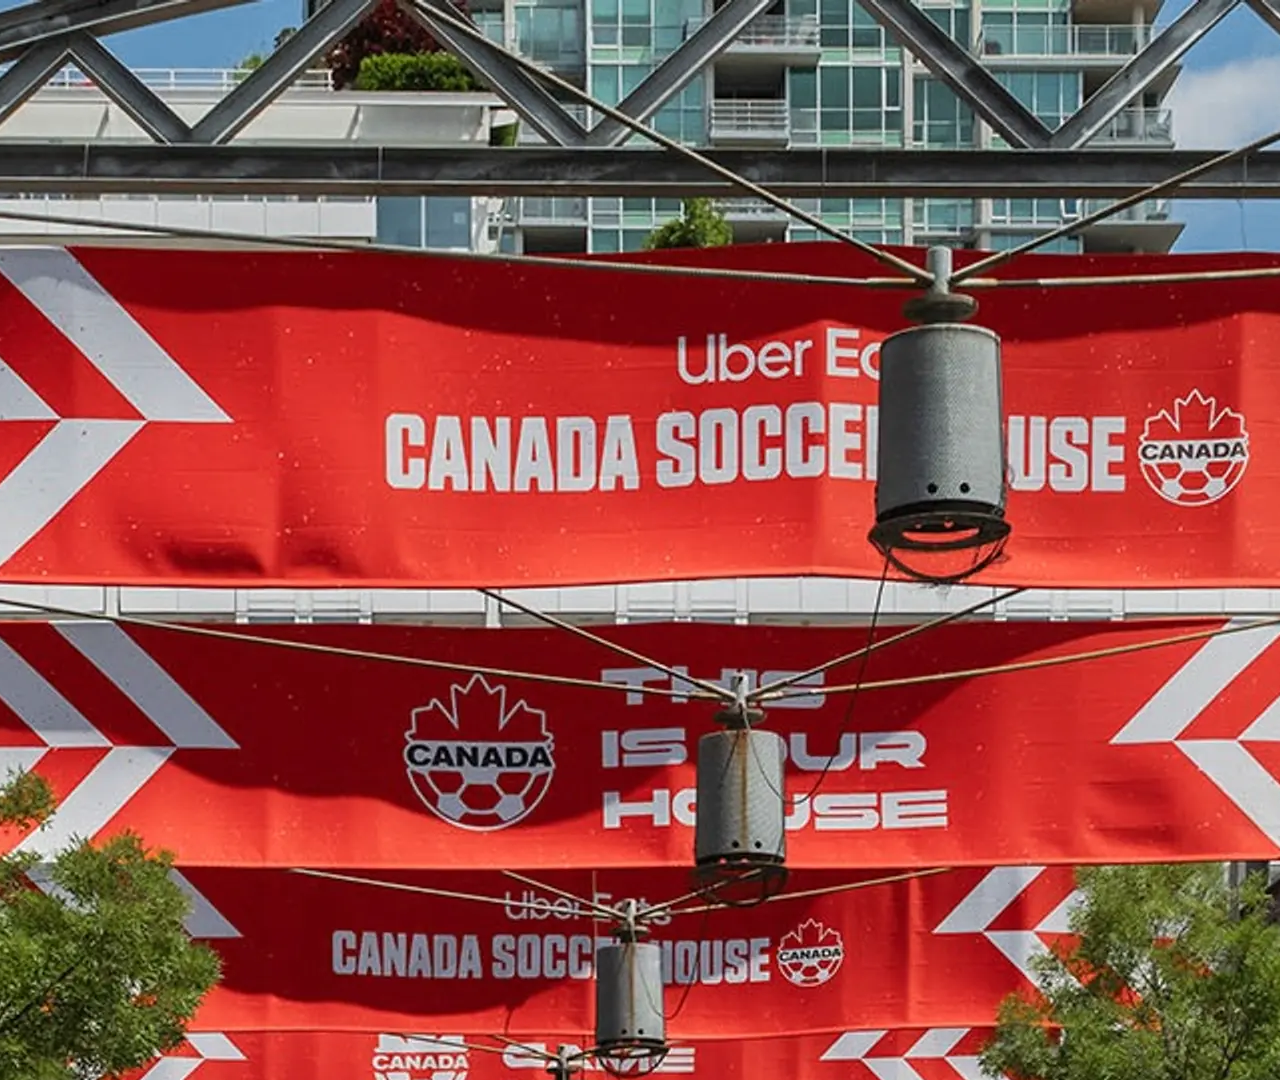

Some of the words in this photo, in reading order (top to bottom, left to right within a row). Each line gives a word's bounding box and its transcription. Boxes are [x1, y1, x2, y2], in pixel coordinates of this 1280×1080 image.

[677, 331, 813, 384] Uber
[385, 413, 640, 492] CANADA
[1007, 415, 1125, 493] USE
[1140, 441, 1247, 461] CANADA
[406, 743, 553, 770] CANADA
[601, 728, 687, 768] IS
[780, 730, 927, 771] UR
[505, 890, 580, 920] Uber
[331, 930, 483, 979] CANADA
[779, 948, 841, 961] CANADA
[372, 1055, 469, 1071] CANADA
